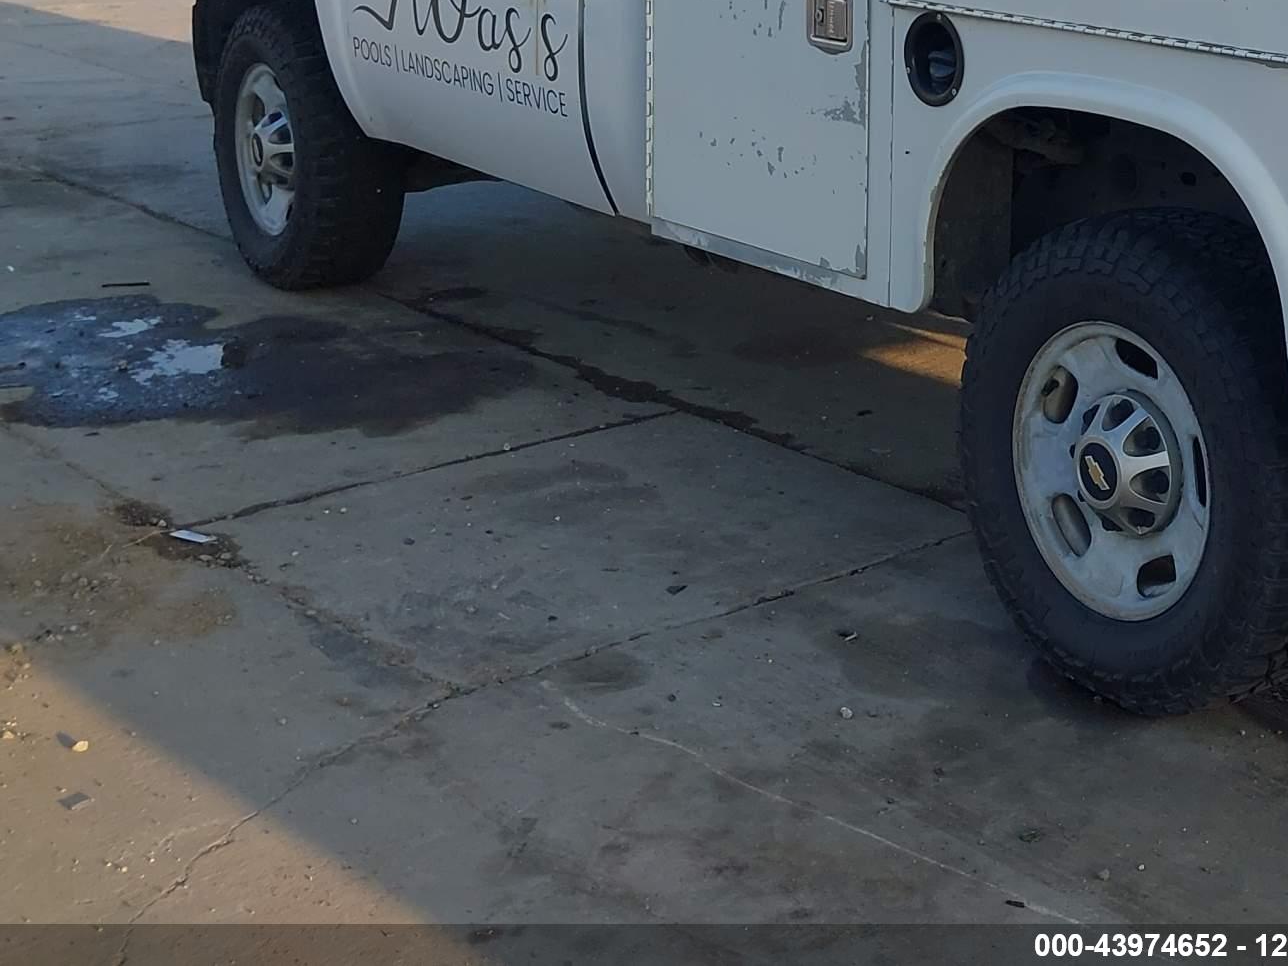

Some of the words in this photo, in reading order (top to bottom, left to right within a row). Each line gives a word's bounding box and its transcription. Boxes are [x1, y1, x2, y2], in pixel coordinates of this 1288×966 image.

[353, 36, 392, 67] POOLS
[401, 49, 494, 96] LANDSCAPING
[506, 79, 568, 117] SERVICE
